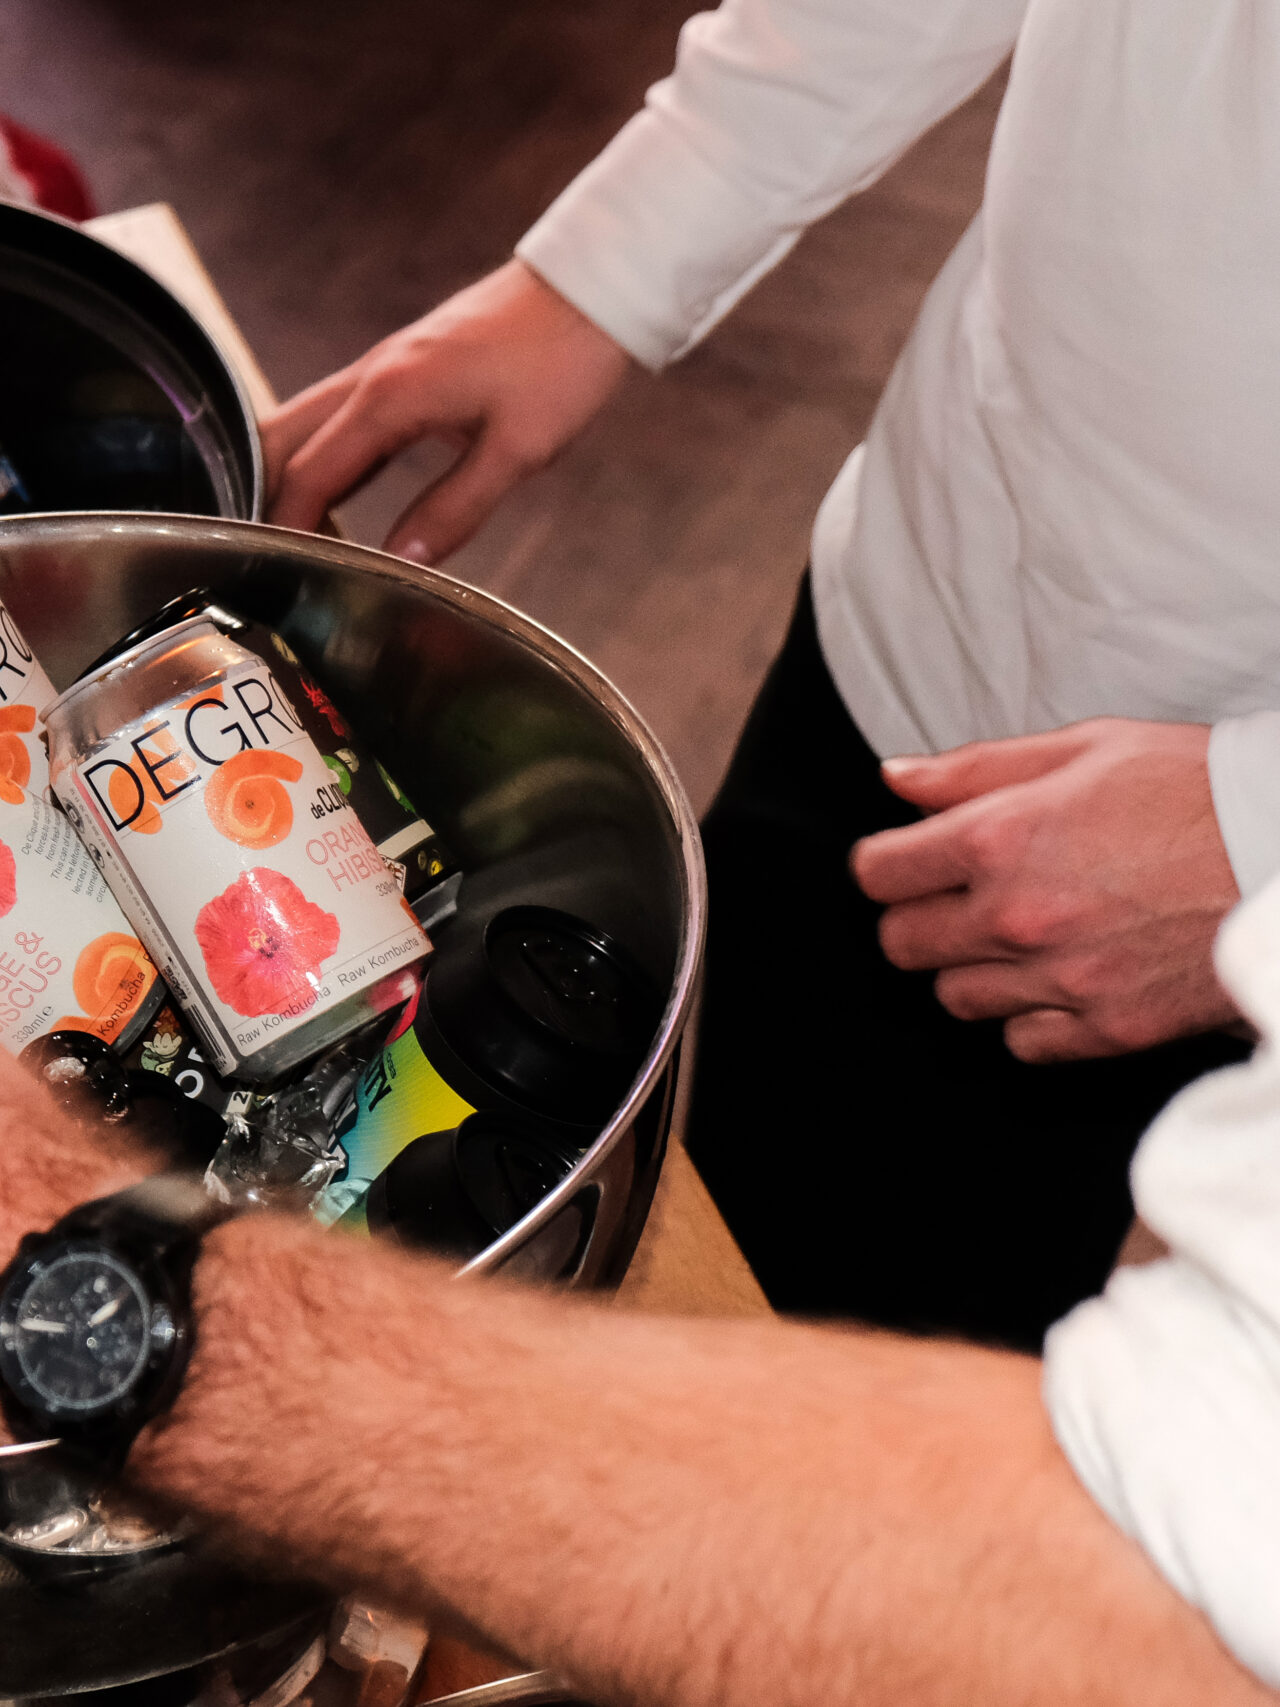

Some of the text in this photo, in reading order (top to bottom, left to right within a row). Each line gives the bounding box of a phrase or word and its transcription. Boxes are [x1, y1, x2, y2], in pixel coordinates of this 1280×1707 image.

[306, 820, 373, 865] ORAN
[14, 931, 44, 955] &
[96, 971, 146, 1036] Kombucha
[236, 937, 419, 1046] Raw Kombucha Raw Kombucha
